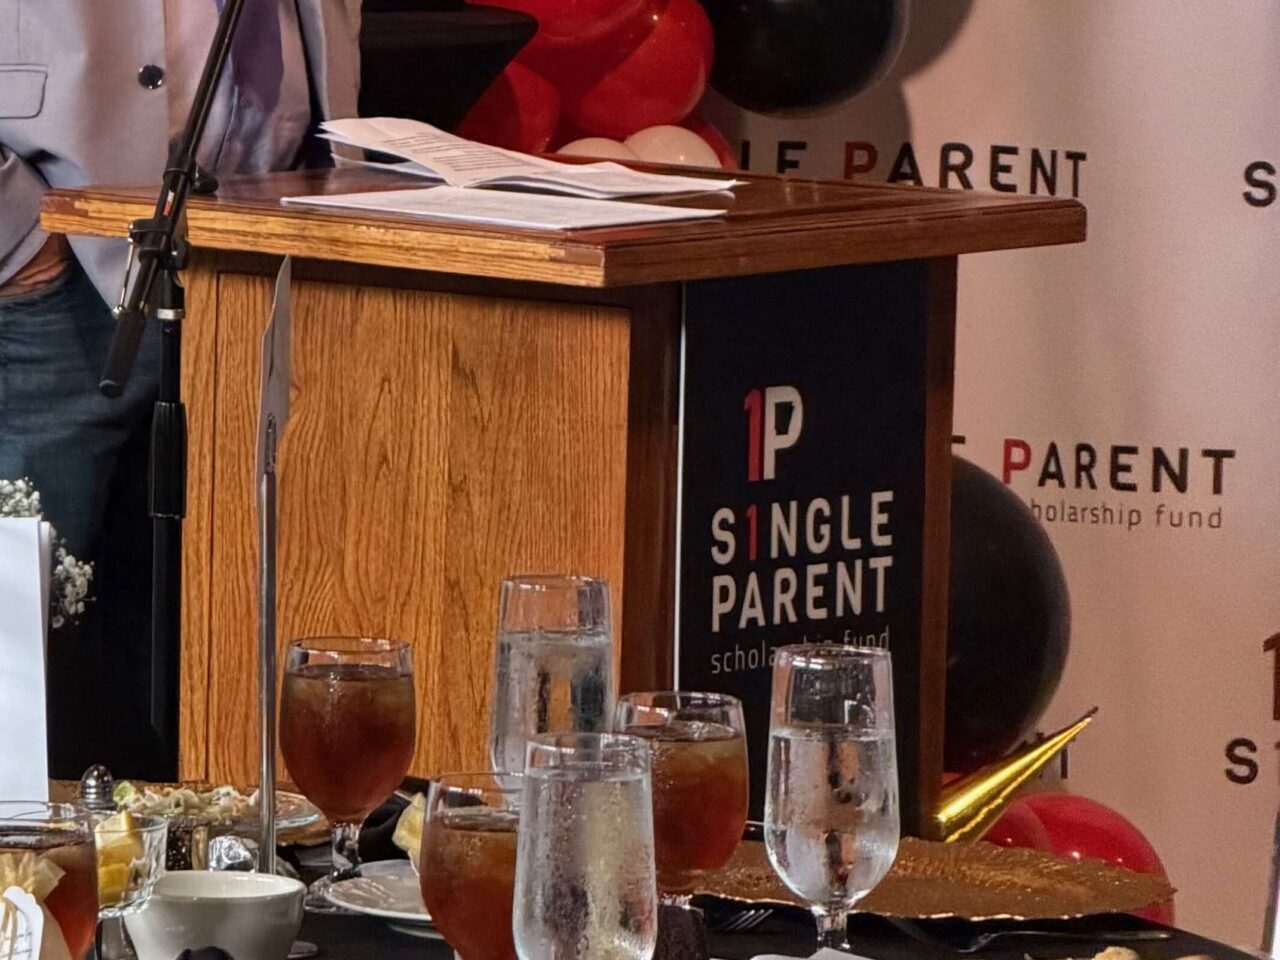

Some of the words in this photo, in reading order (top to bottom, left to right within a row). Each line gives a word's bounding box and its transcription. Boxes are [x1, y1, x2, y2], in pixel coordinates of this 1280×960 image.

[844, 142, 1087, 198] PARENT
[1243, 160, 1277, 208] S
[743, 385, 804, 482] 1P
[1002, 438, 1236, 495] PARENT
[1031, 498, 1142, 531] holarship
[1156, 503, 1222, 529] fund
[711, 556, 894, 633] PARENT
